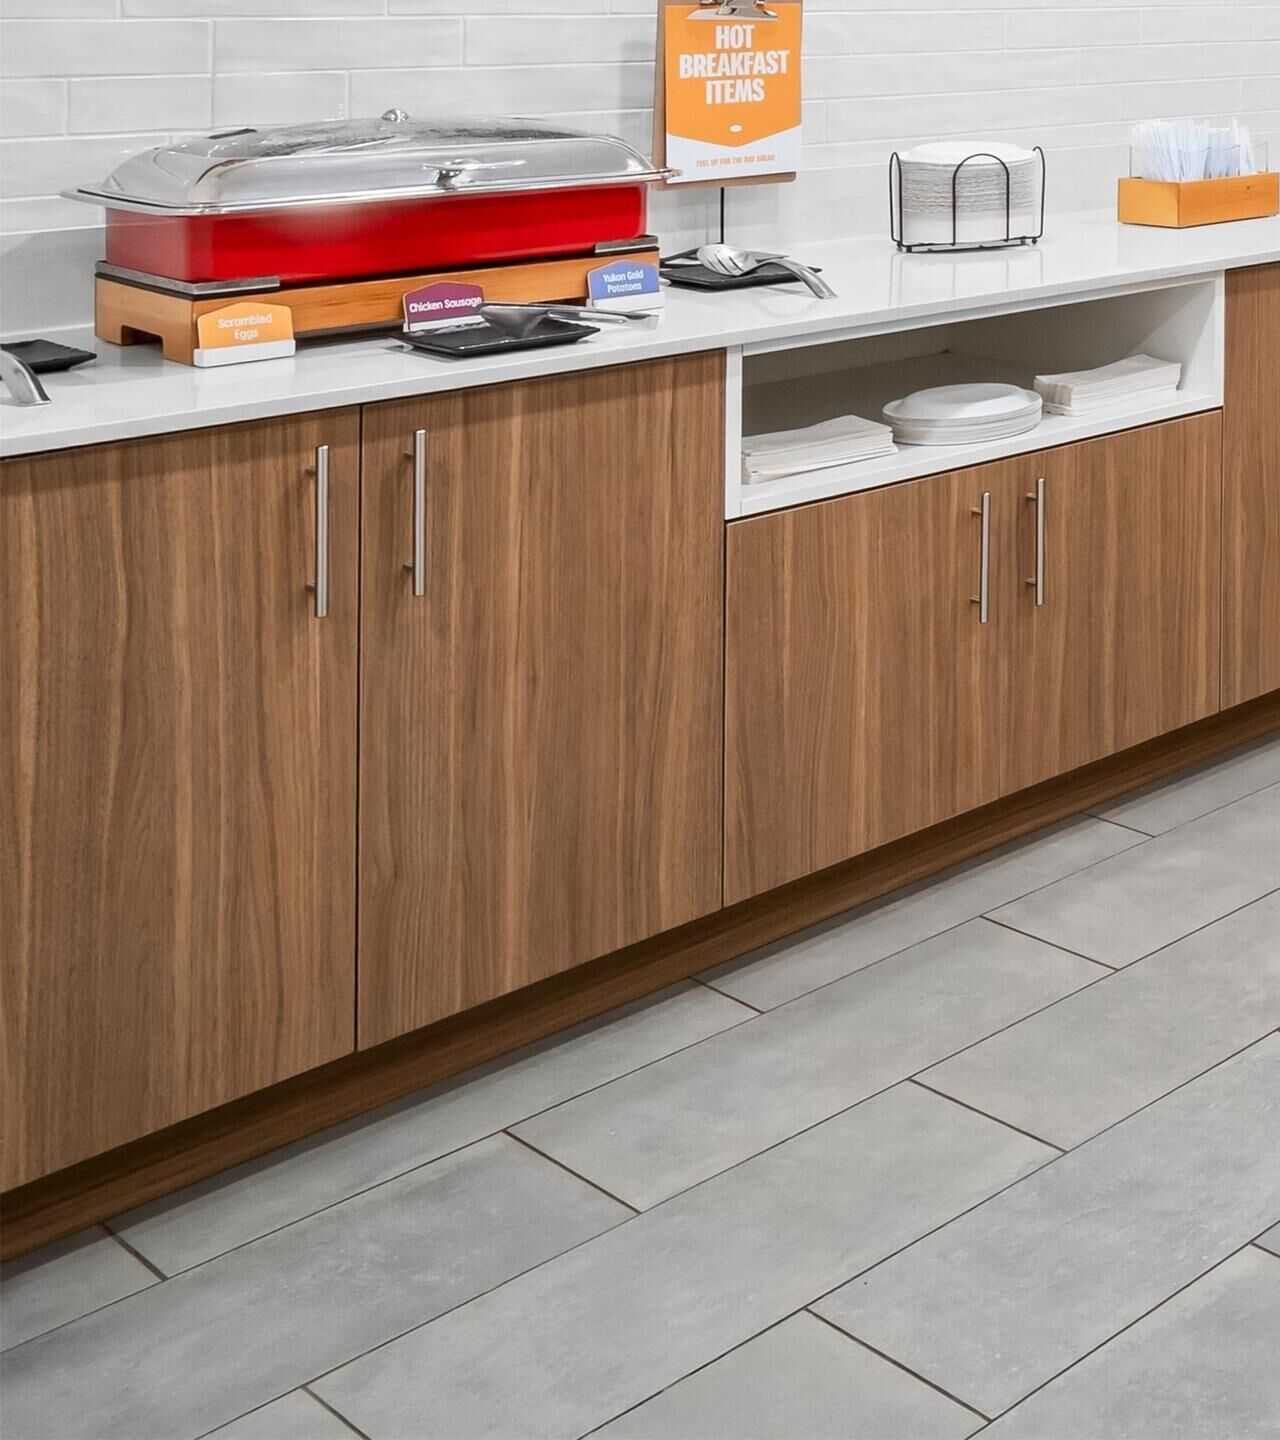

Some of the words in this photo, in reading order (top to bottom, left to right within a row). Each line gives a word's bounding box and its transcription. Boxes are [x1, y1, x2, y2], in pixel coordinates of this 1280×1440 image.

[715, 24, 755, 49] HOT
[679, 50, 790, 79] BREAKFAST
[705, 78, 765, 105] ITEMS
[603, 273, 626, 283] Yukon
[627, 270, 644, 280] Gold
[607, 282, 642, 293] Potatoes
[409, 300, 443, 313] Chicken
[217, 313, 273, 329] Scrambled
[233, 329, 258, 341] Eggs
